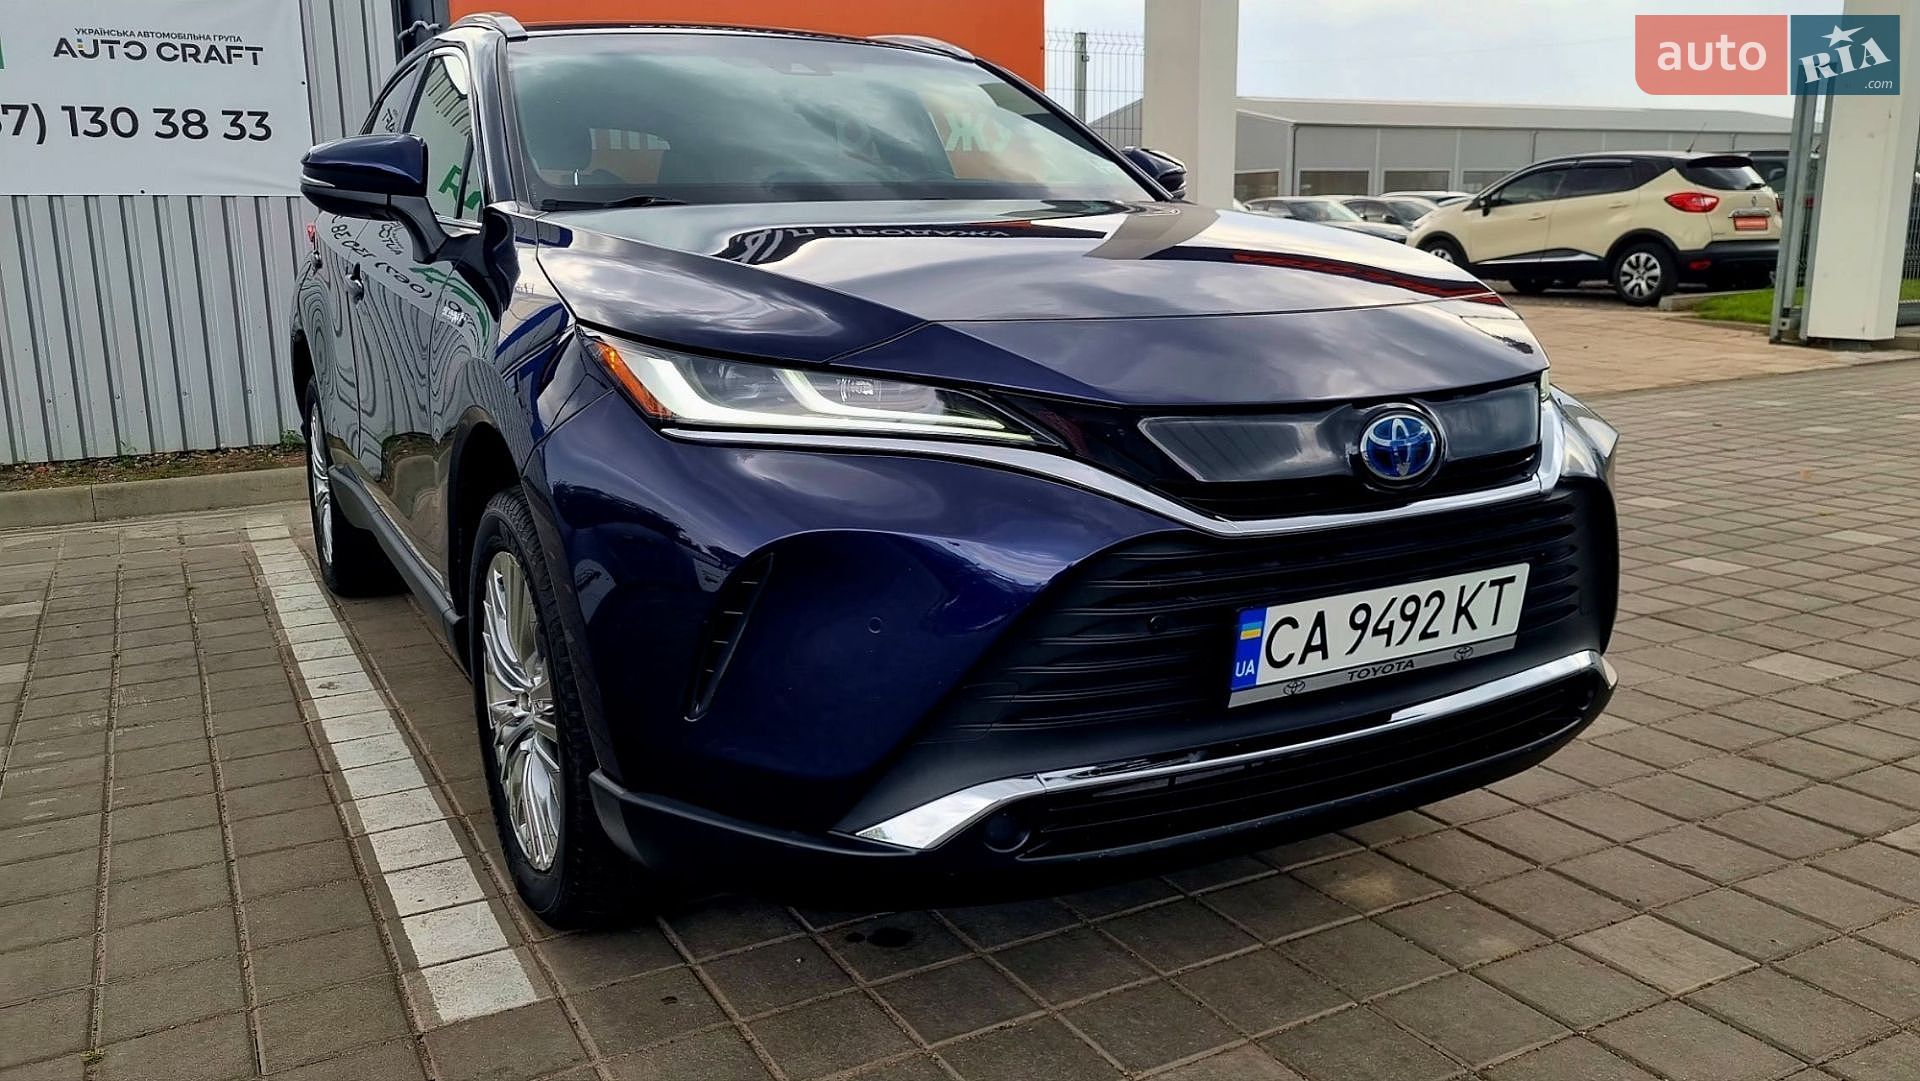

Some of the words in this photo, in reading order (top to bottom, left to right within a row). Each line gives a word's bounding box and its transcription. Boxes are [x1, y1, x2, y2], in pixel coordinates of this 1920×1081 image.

[74, 27, 136, 38] УКРАЇНСЬКА
[136, 31, 211, 42] АВТОМОБІЛЬНА
[212, 34, 243, 43] ГРУПА
[53, 37, 147, 61] AUTO
[156, 42, 264, 66] CRAFT
[0, 103, 47, 145] 7)
[61, 105, 139, 139] 130
[152, 108, 209, 140] 38
[221, 110, 272, 141] 33
[1265, 610, 1329, 669] CA
[1345, 590, 1446, 655] 9492
[1452, 575, 1517, 634] KT
[1235, 660, 1256, 677] UA
[1347, 659, 1416, 682] TOYOTA
